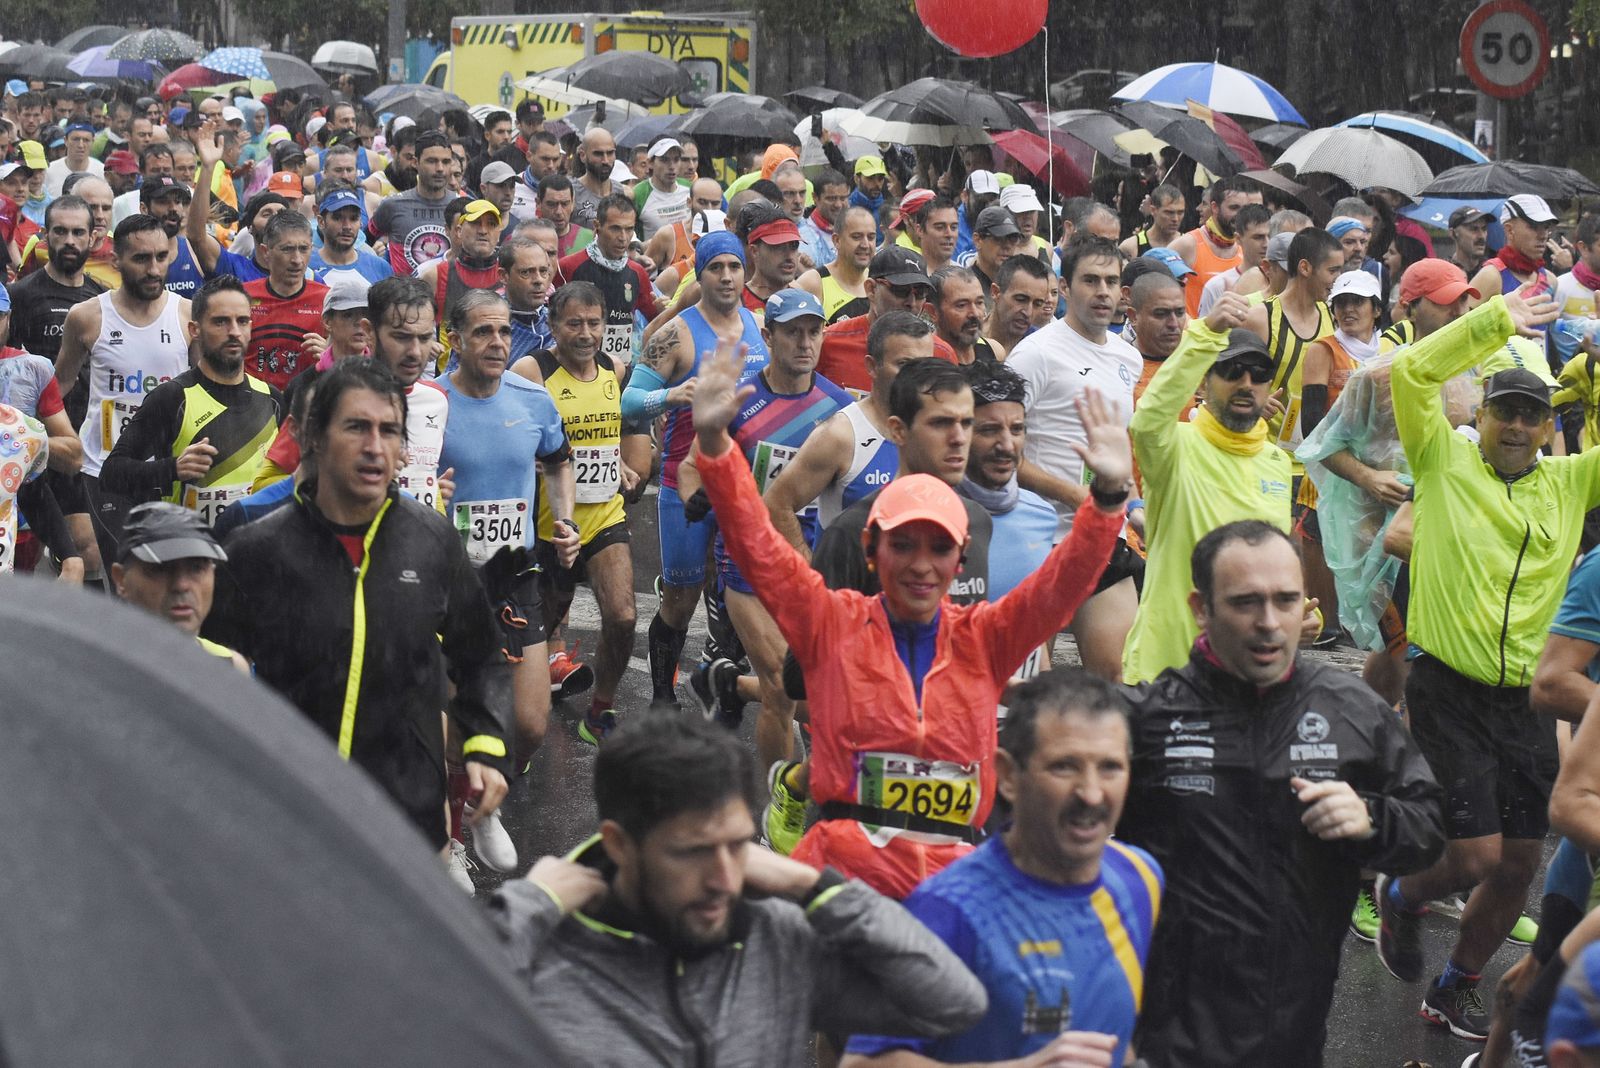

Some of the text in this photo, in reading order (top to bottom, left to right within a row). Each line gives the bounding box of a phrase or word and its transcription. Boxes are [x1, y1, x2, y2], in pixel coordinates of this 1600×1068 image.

[648, 34, 694, 57] DYA
[1482, 32, 1532, 65] 50
[609, 309, 634, 321] Arjon
[743, 353, 765, 363] pyou
[109, 369, 173, 394] inde
[562, 411, 621, 426] LUB ATLETIS
[408, 453, 440, 466] EVILL
[576, 461, 618, 484] 2276
[472, 516, 522, 543] 3504
[887, 781, 972, 818] 2694
